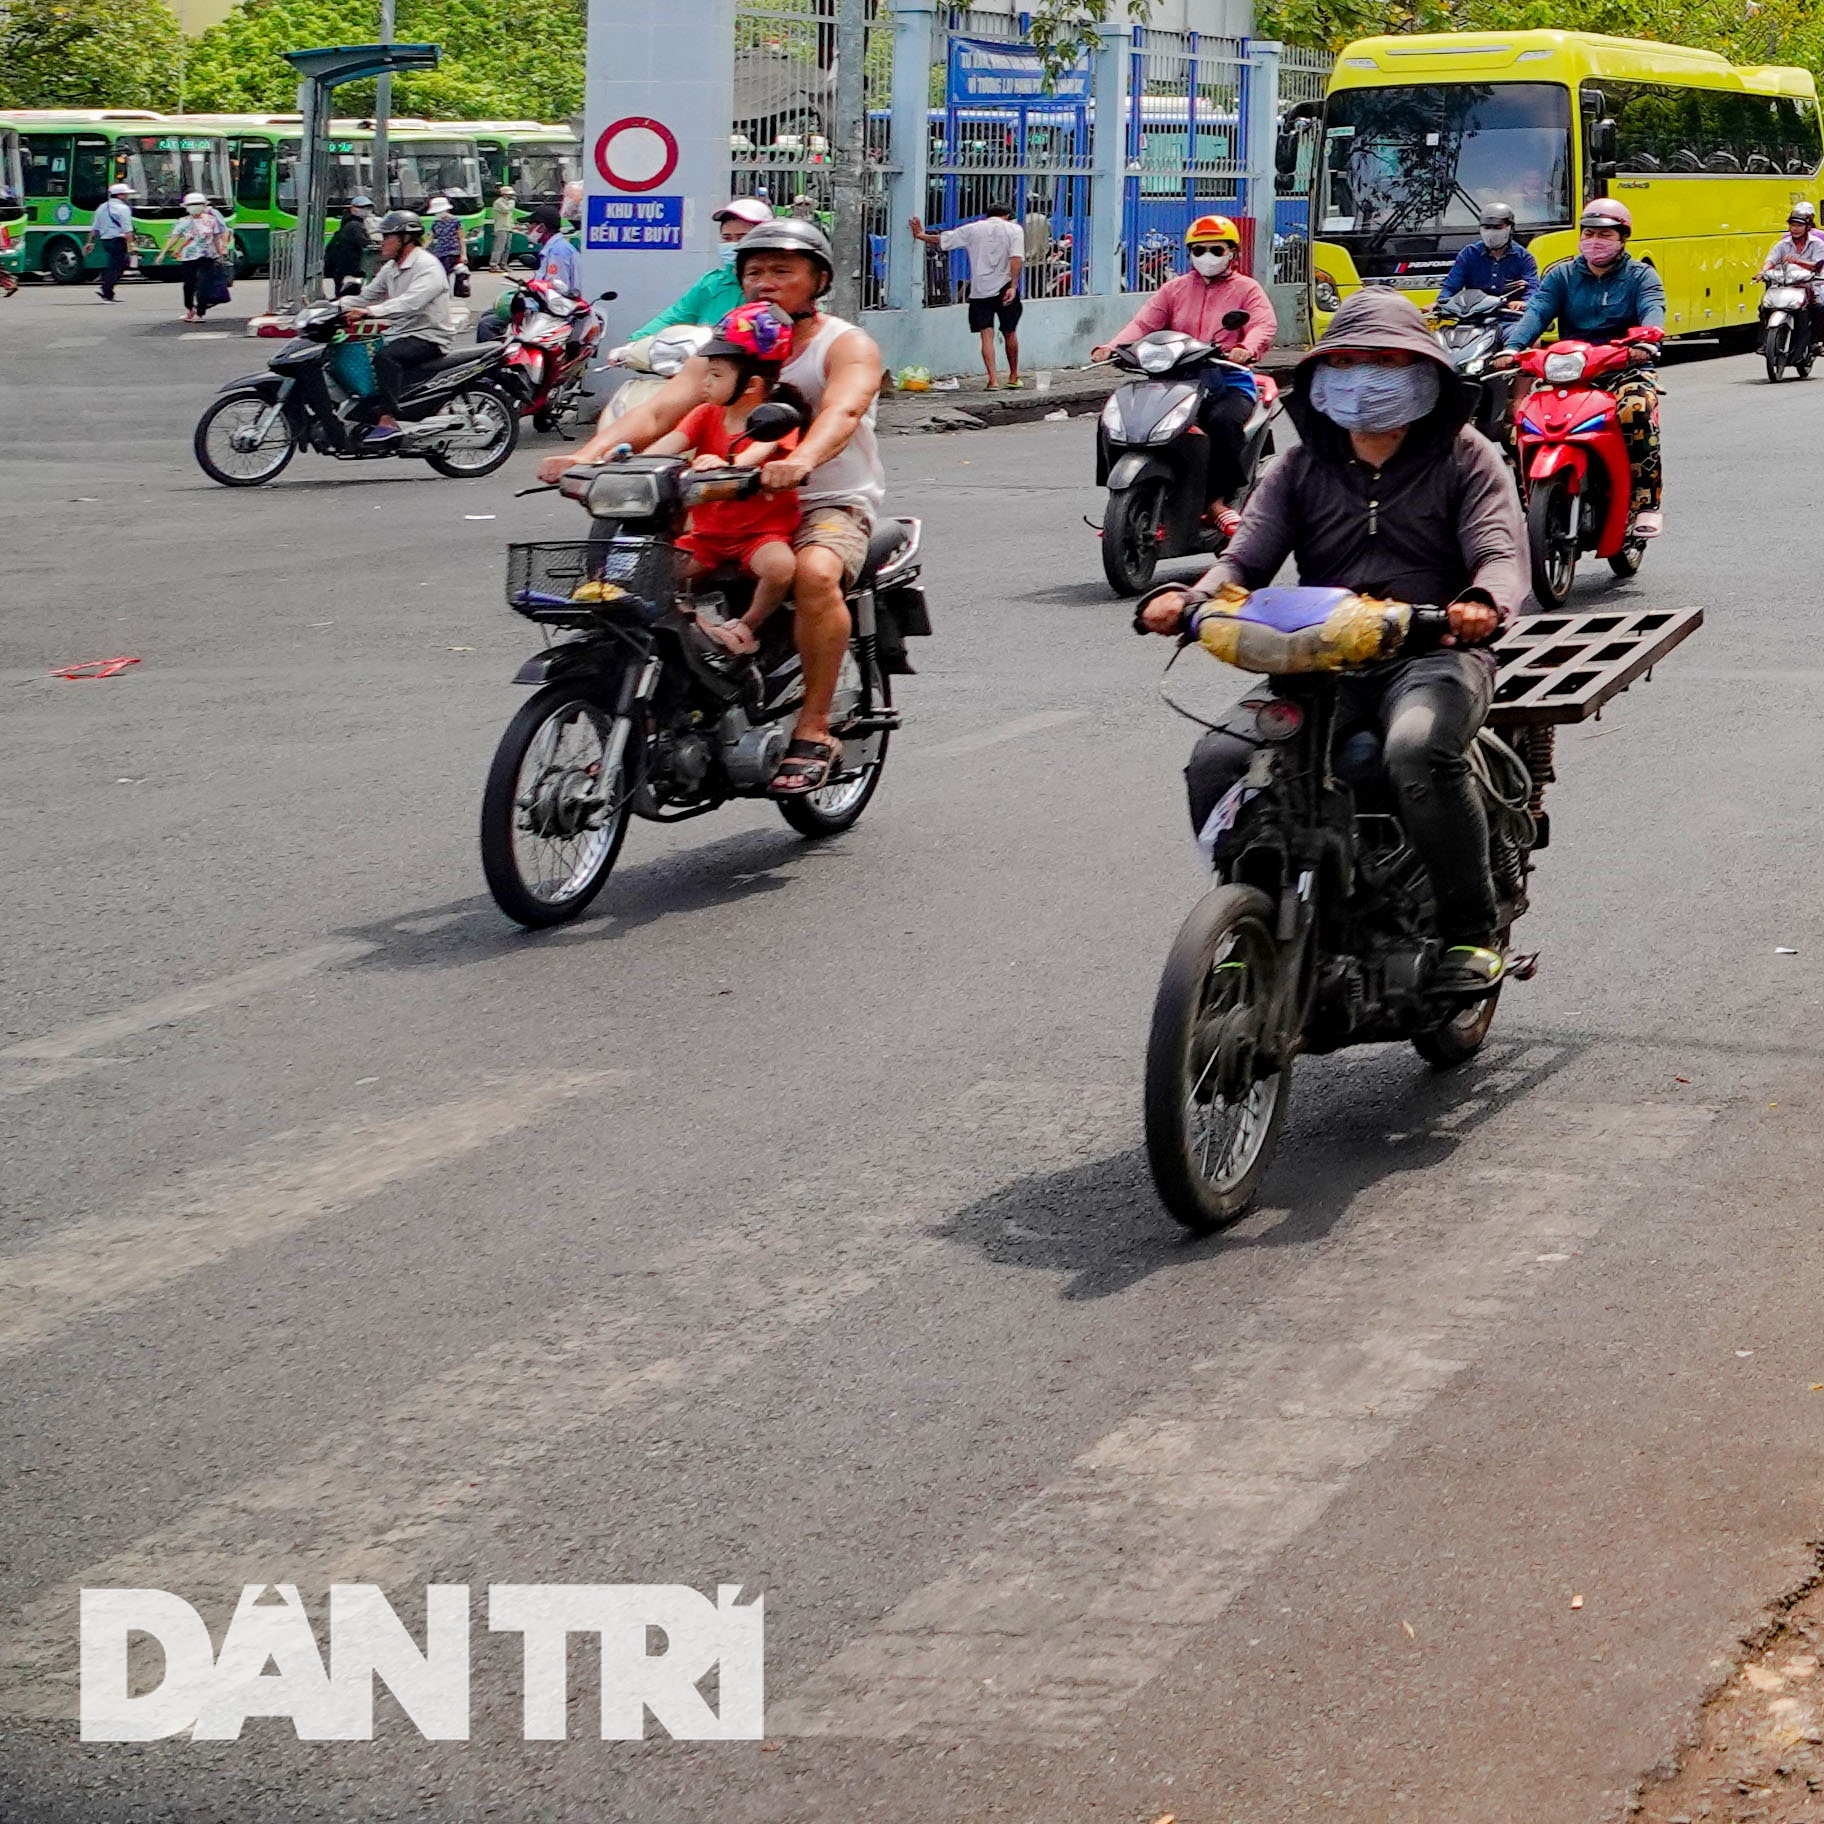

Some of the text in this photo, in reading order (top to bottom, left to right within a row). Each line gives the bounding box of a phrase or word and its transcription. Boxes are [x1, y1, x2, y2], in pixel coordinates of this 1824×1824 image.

[606, 200, 664, 222] KHU VỰC
[590, 220, 680, 244] BẾN XE BUÝT
